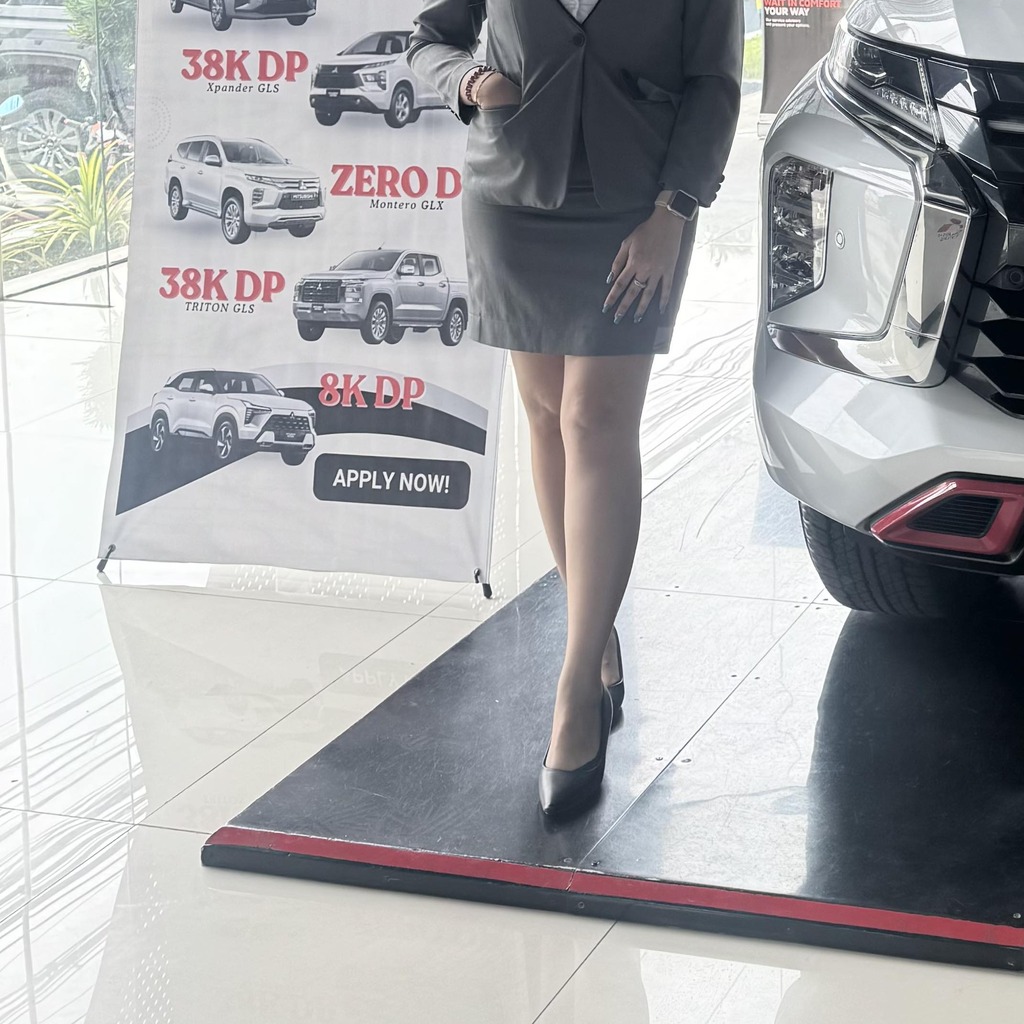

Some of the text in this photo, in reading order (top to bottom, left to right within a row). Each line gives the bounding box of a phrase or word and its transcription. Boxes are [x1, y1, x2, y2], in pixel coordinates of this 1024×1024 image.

[764, 6, 810, 16] YOUR WAY
[798, 0, 842, 8] COMFORT
[181, 49, 309, 83] 38K DP
[206, 82, 280, 94] Xpander GLS
[330, 164, 462, 199] ZERO D
[369, 198, 444, 211] Montero GLX
[158, 267, 286, 304] 38K DP
[184, 301, 255, 314] TRITON GLS
[318, 372, 425, 410] 8K DP
[332, 468, 450, 494] APPLY NOW!
